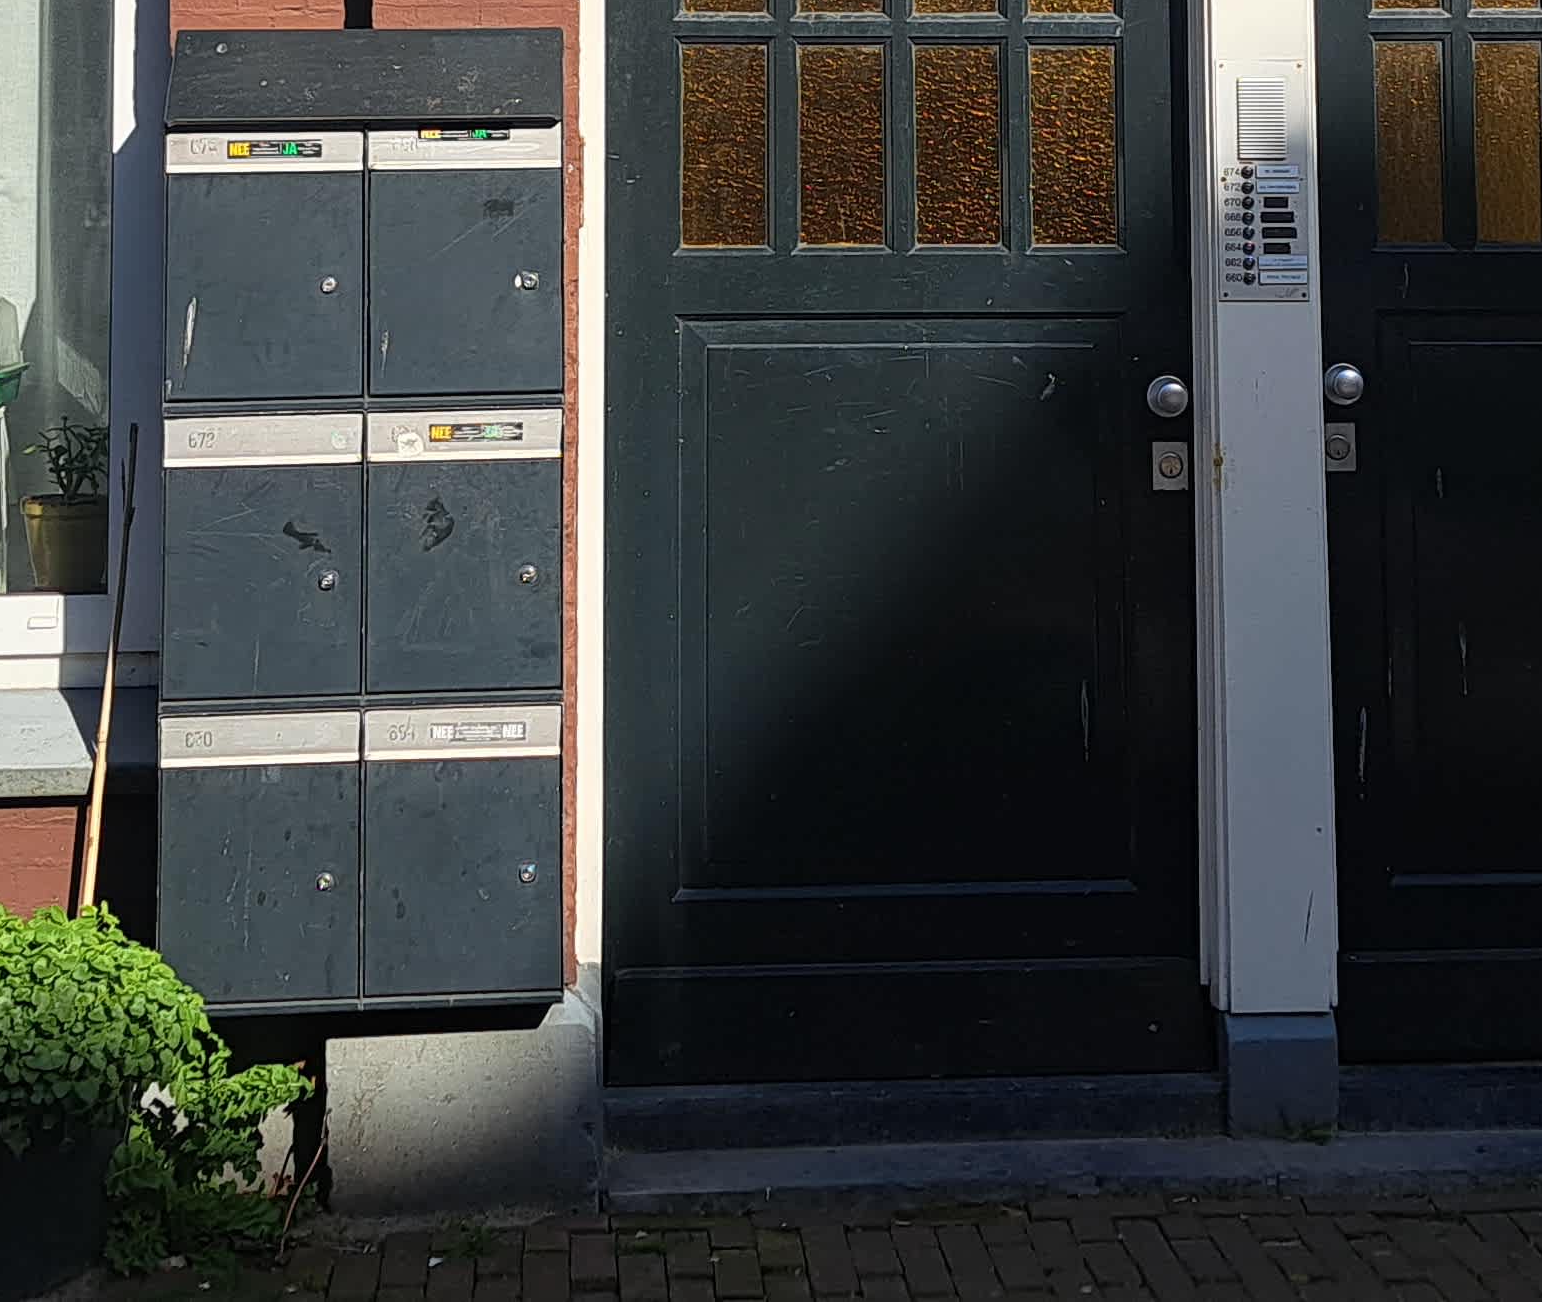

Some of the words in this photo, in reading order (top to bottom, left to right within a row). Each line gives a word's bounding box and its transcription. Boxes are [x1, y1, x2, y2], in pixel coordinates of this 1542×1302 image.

[229, 142, 250, 156] NEE
[282, 142, 297, 155] JA
[431, 426, 452, 439] NEE
[188, 432, 215, 448] 672
[432, 725, 455, 739] NEE
[502, 724, 524, 739] NEE
